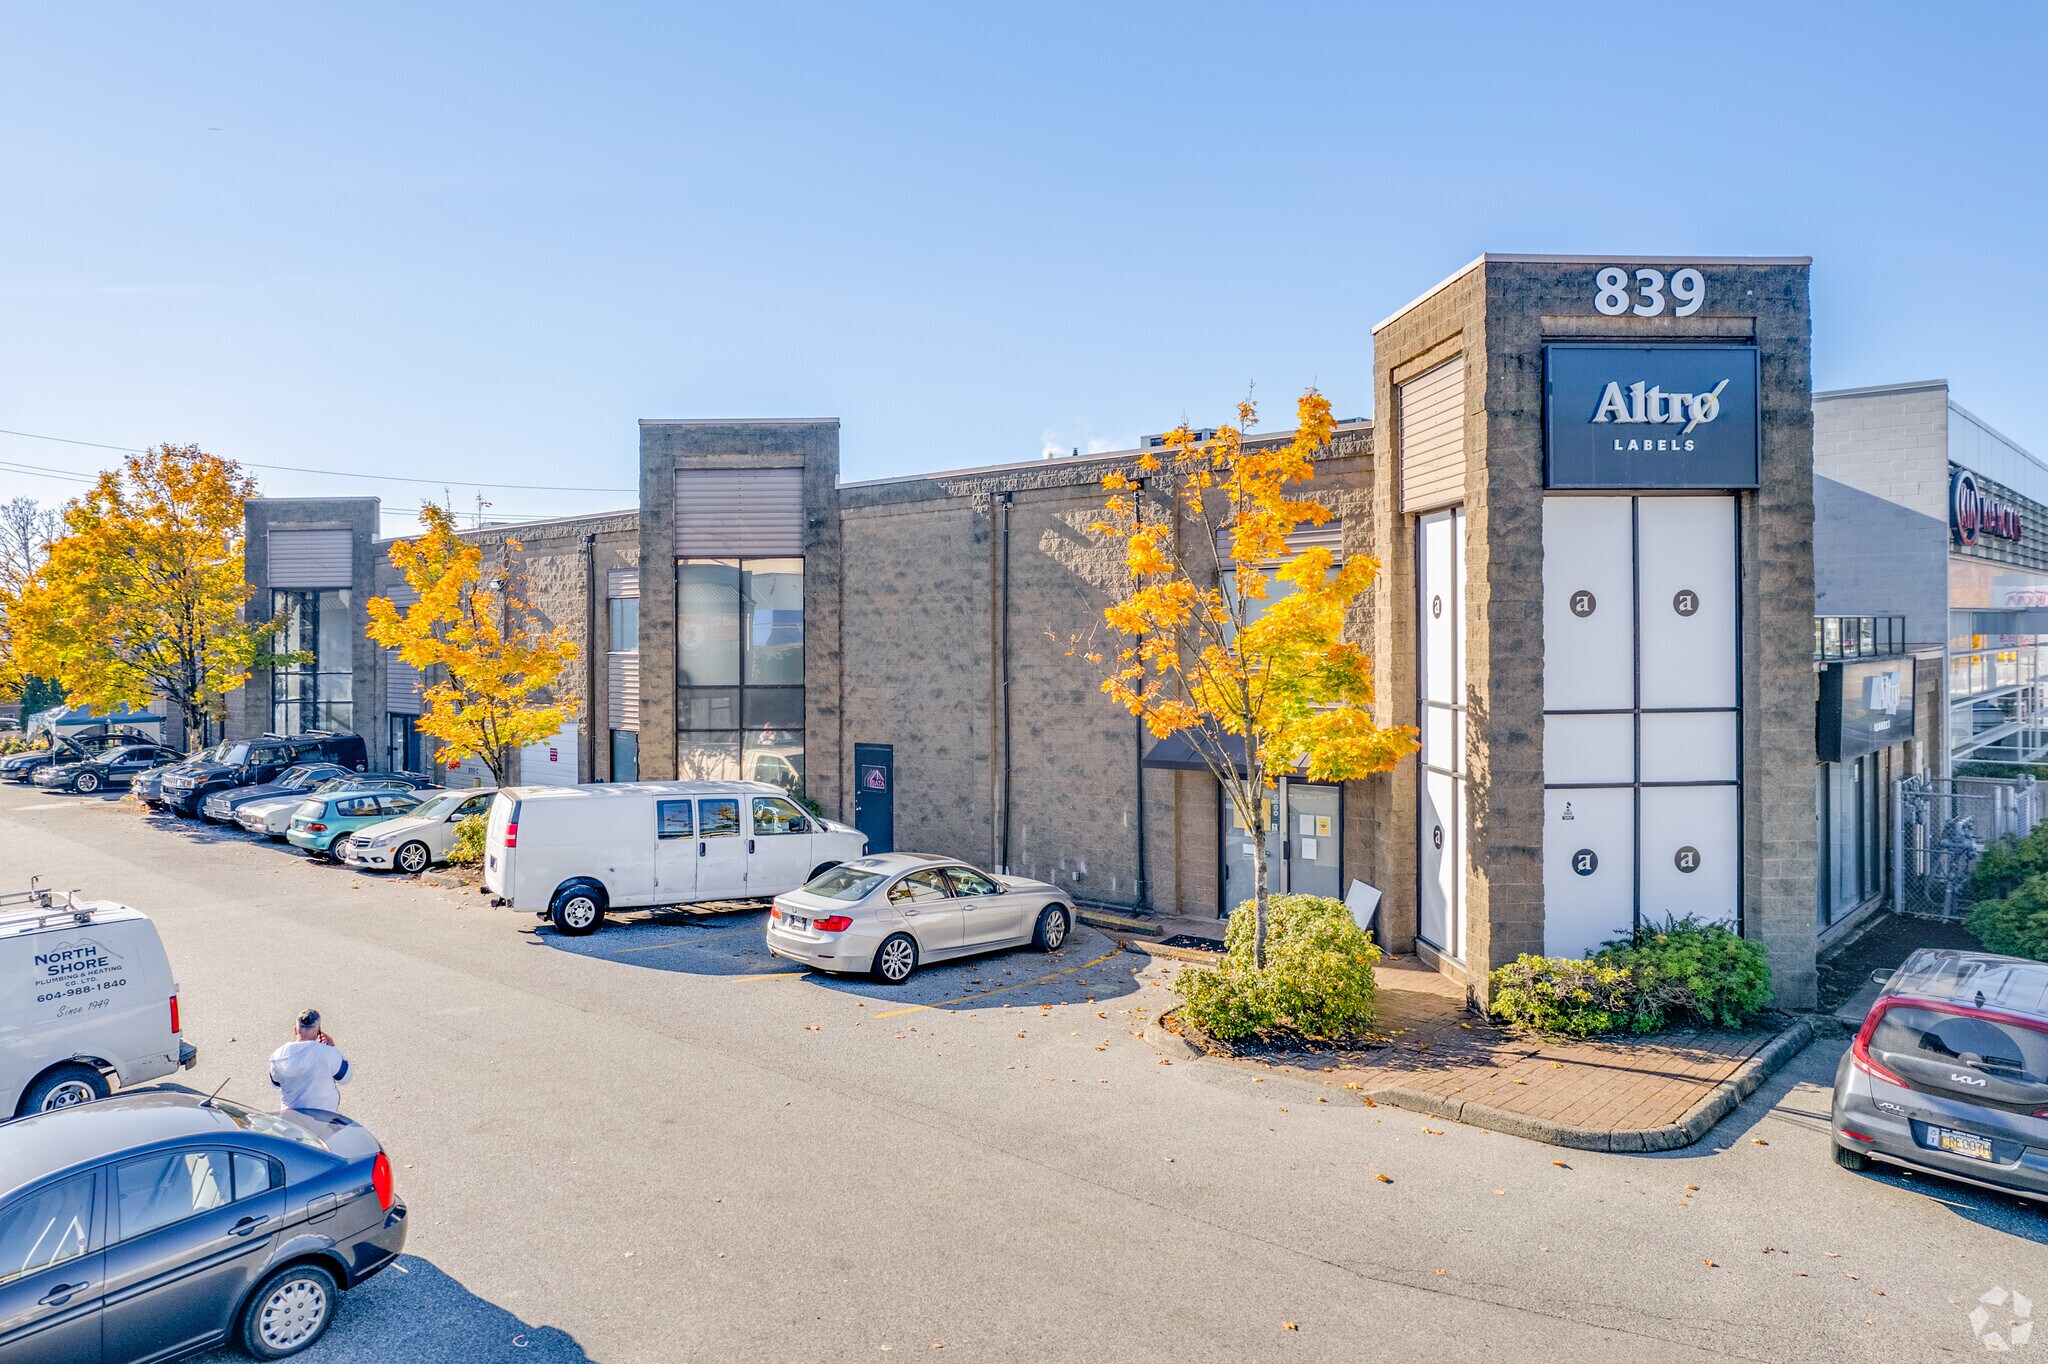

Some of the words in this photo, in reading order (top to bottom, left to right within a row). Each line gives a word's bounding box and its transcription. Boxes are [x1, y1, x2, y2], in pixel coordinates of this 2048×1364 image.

[1594, 267, 1706, 317] 839
[1613, 439, 1695, 451] LABELS
[34, 946, 97, 966] NORTH
[48, 956, 109, 976] SHORE
[35, 973, 79, 986] PLUMBING
[88, 965, 122, 976] HEATING
[81, 976, 98, 984] LTD.
[37, 978, 127, 1003] 604-988-1840
[56, 1005, 82, 1018] Since
[88, 998, 110, 1011] 1949
